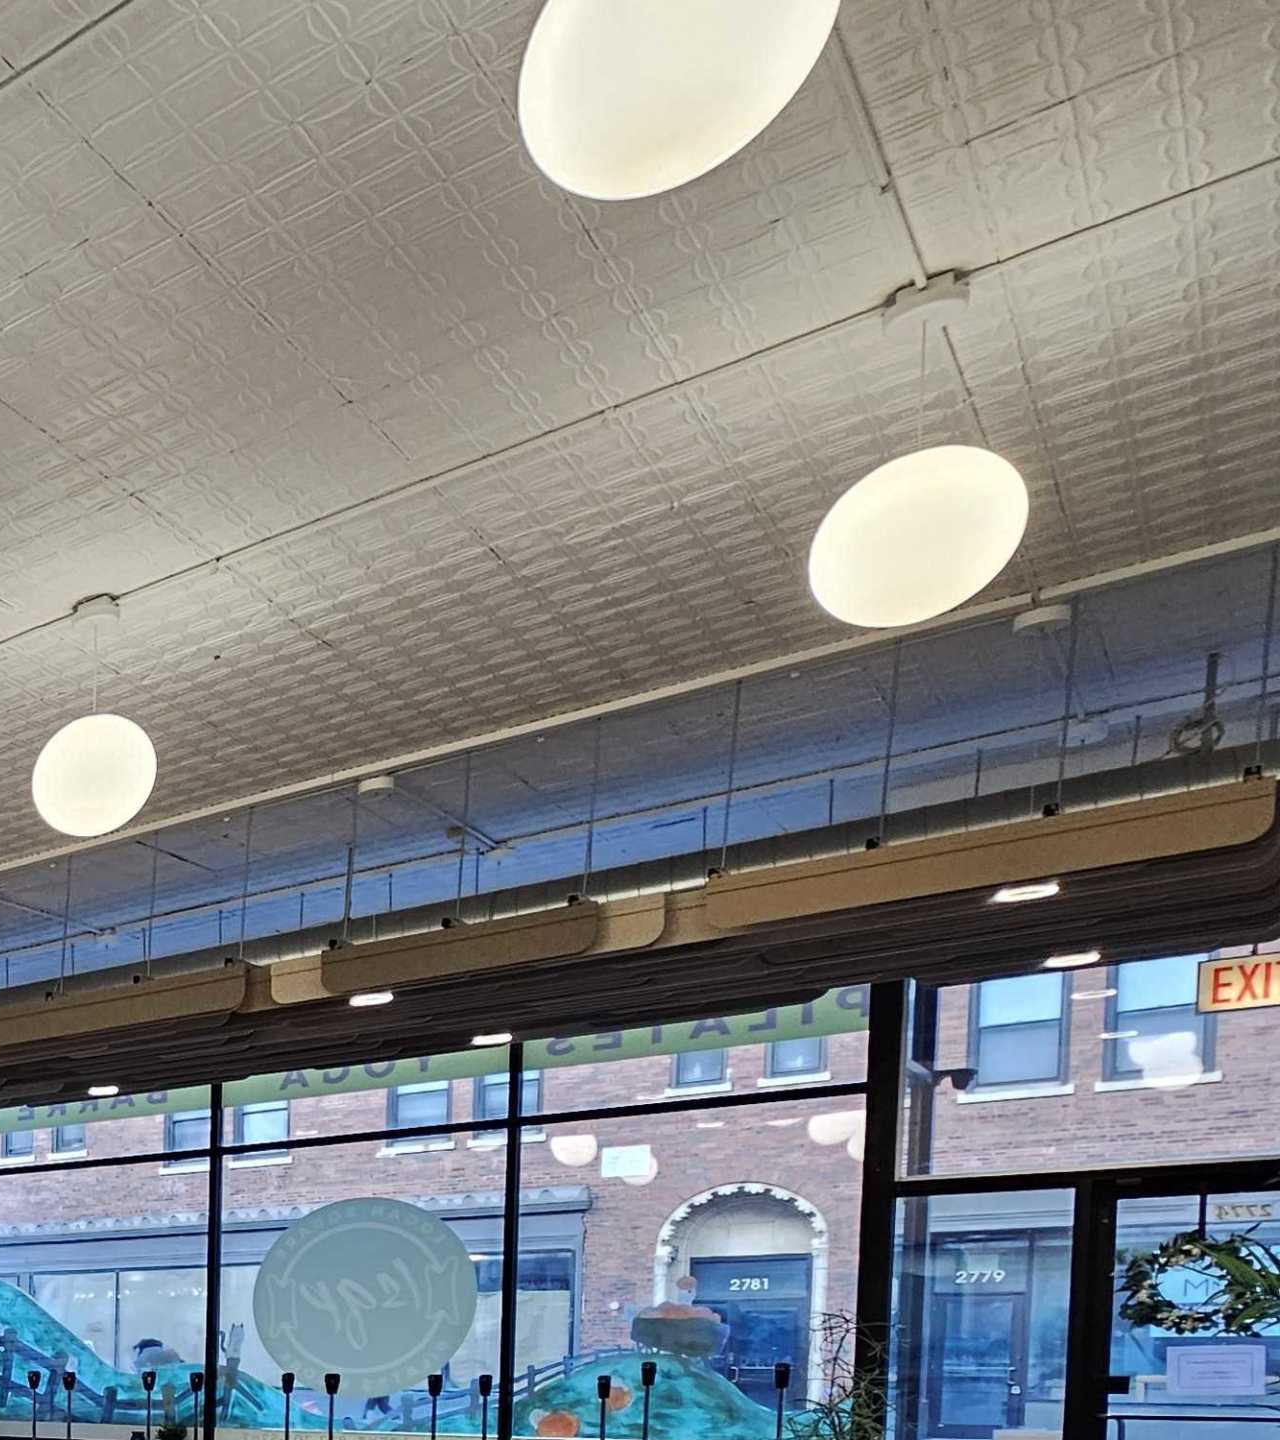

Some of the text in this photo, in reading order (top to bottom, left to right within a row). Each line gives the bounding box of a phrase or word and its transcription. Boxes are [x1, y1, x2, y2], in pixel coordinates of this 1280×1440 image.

[1212, 961, 1280, 1004] EXI
[955, 1270, 1006, 1284] 2779
[729, 1278, 770, 1291] 2781
